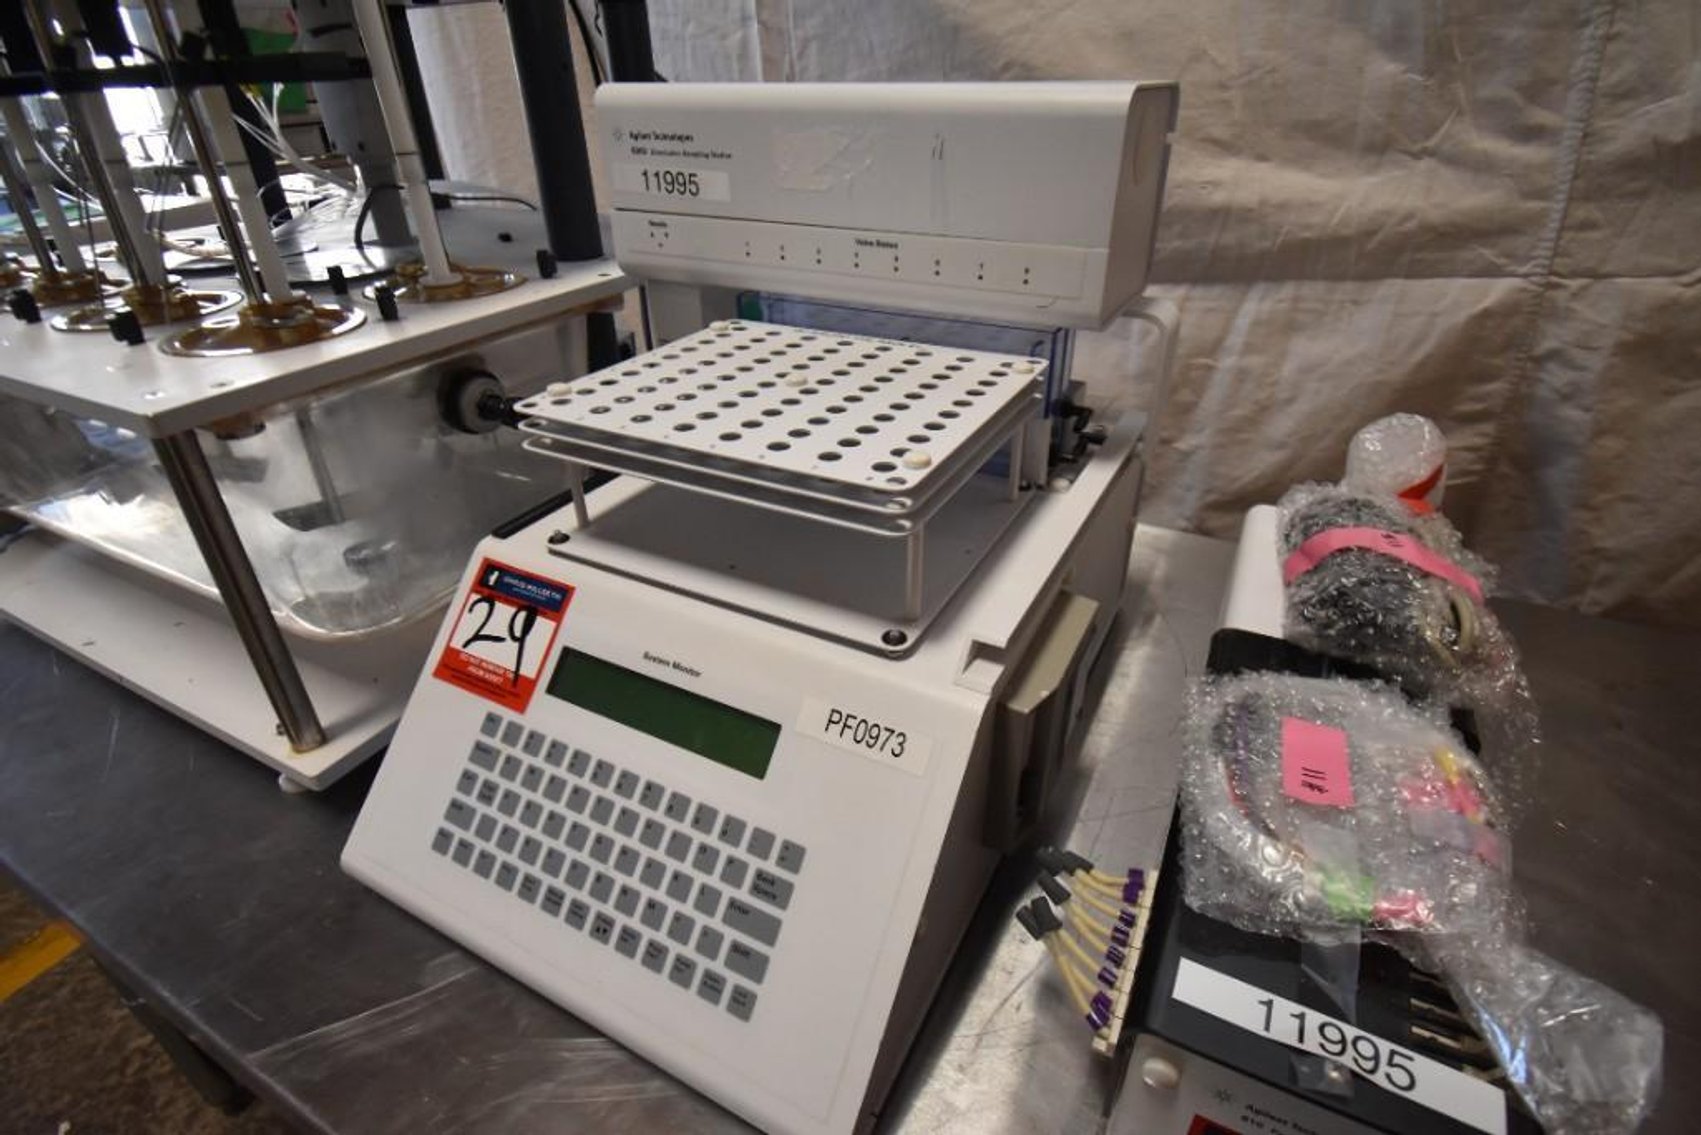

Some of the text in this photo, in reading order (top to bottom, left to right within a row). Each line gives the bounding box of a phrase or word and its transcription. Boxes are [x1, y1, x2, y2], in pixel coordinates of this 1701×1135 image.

[641, 168, 700, 197] 11995
[462, 596, 537, 688] 29
[825, 708, 907, 758] PF0973
[1256, 998, 1417, 1092] 11995
